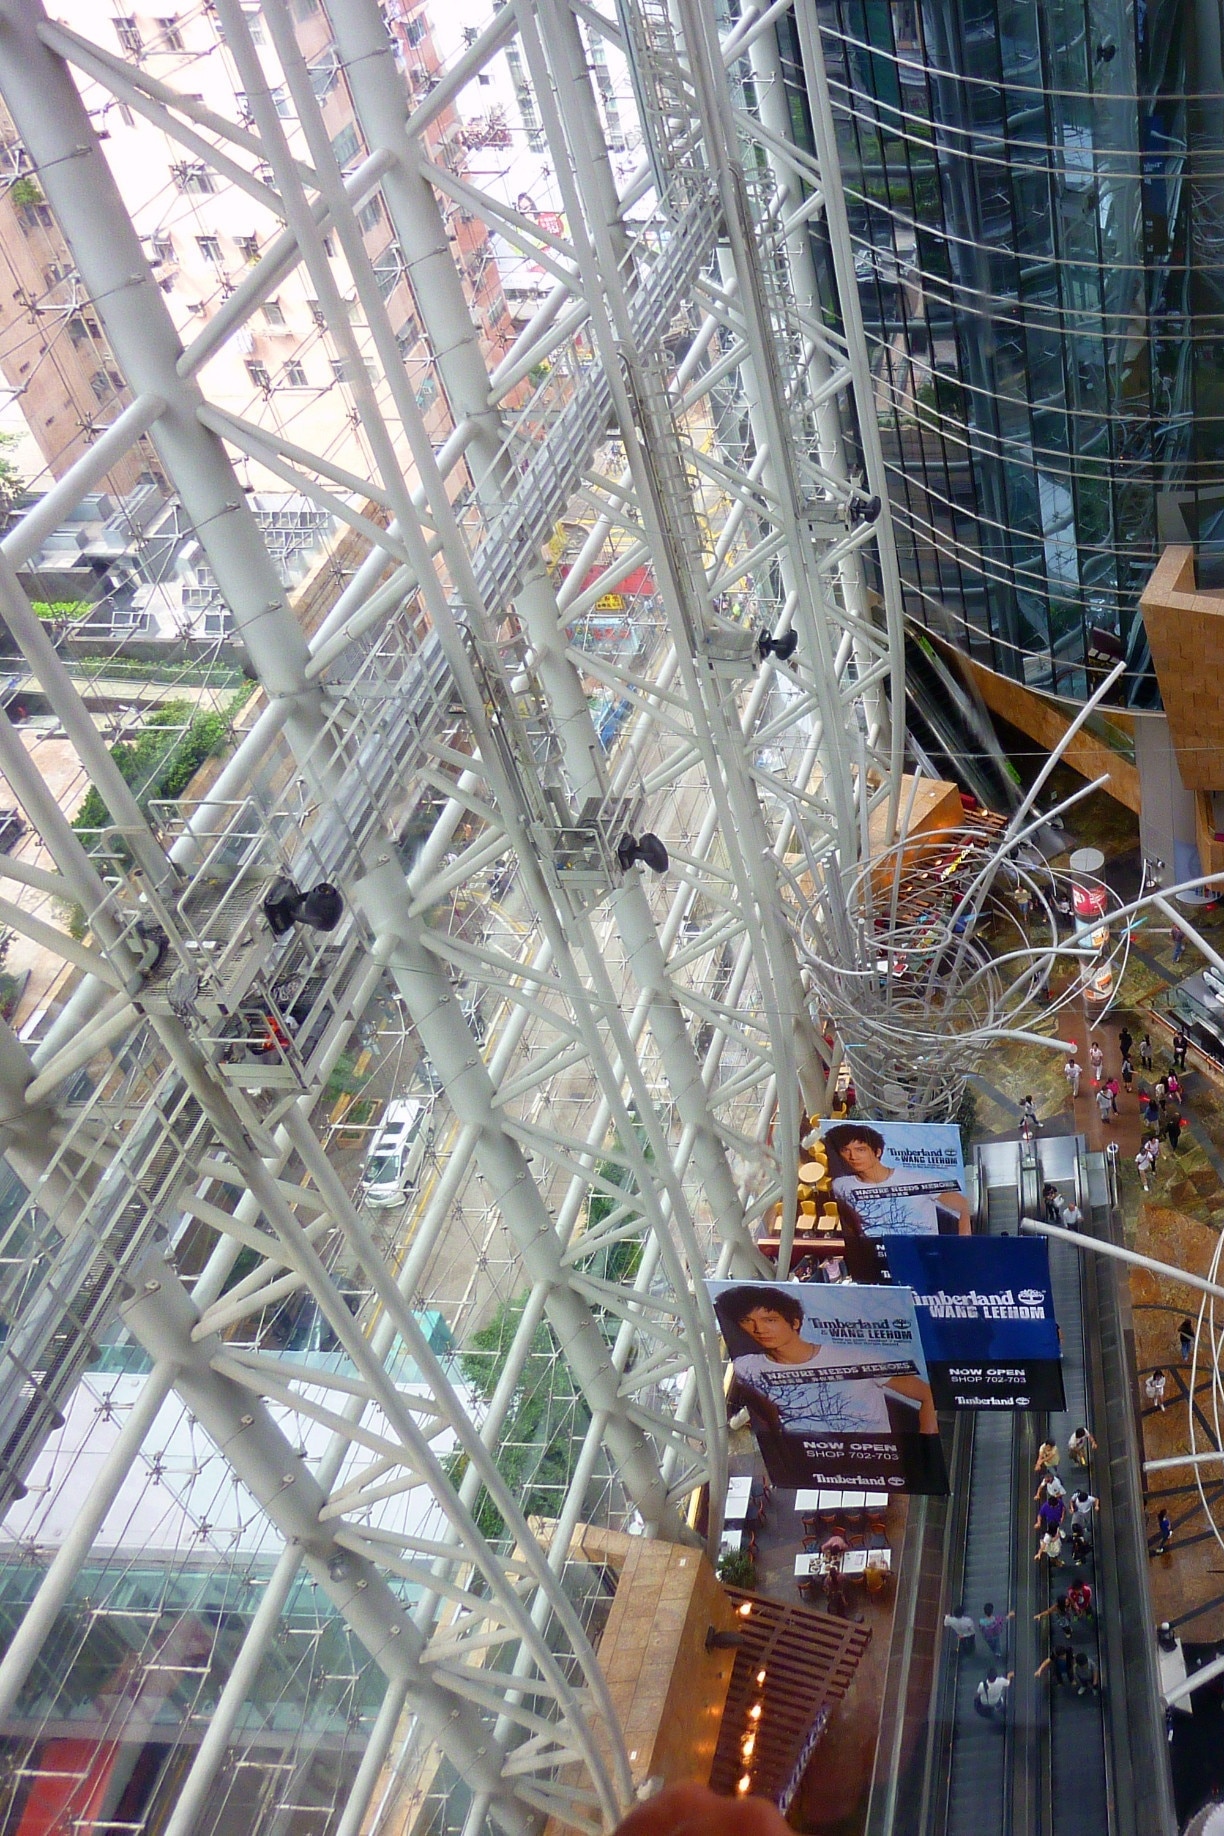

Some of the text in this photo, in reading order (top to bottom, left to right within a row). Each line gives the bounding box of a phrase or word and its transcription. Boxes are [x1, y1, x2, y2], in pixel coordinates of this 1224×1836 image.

[887, 1147, 943, 1157] Timberland
[901, 1156, 926, 1164] WANG
[928, 1157, 958, 1165] LEEHOM
[855, 1186, 889, 1196] NATURE
[891, 1184, 919, 1194] NEEDS
[929, 1305, 1046, 1319] WANG LEEHOM
[807, 1317, 890, 1330] Timberland
[829, 1328, 864, 1339] WANG
[868, 1329, 912, 1340] LEEHOM
[766, 1370, 816, 1380] NATURE
[818, 1366, 859, 1376] NEEDS
[949, 1368, 983, 1376] NOW
[985, 1376, 1027, 1384] 702-703
[954, 1395, 1014, 1406] Timberland
[803, 1441, 898, 1452] NOW OPEN
[806, 1450, 899, 1460] SHOP 702-703
[813, 1473, 886, 1486] Timberland
